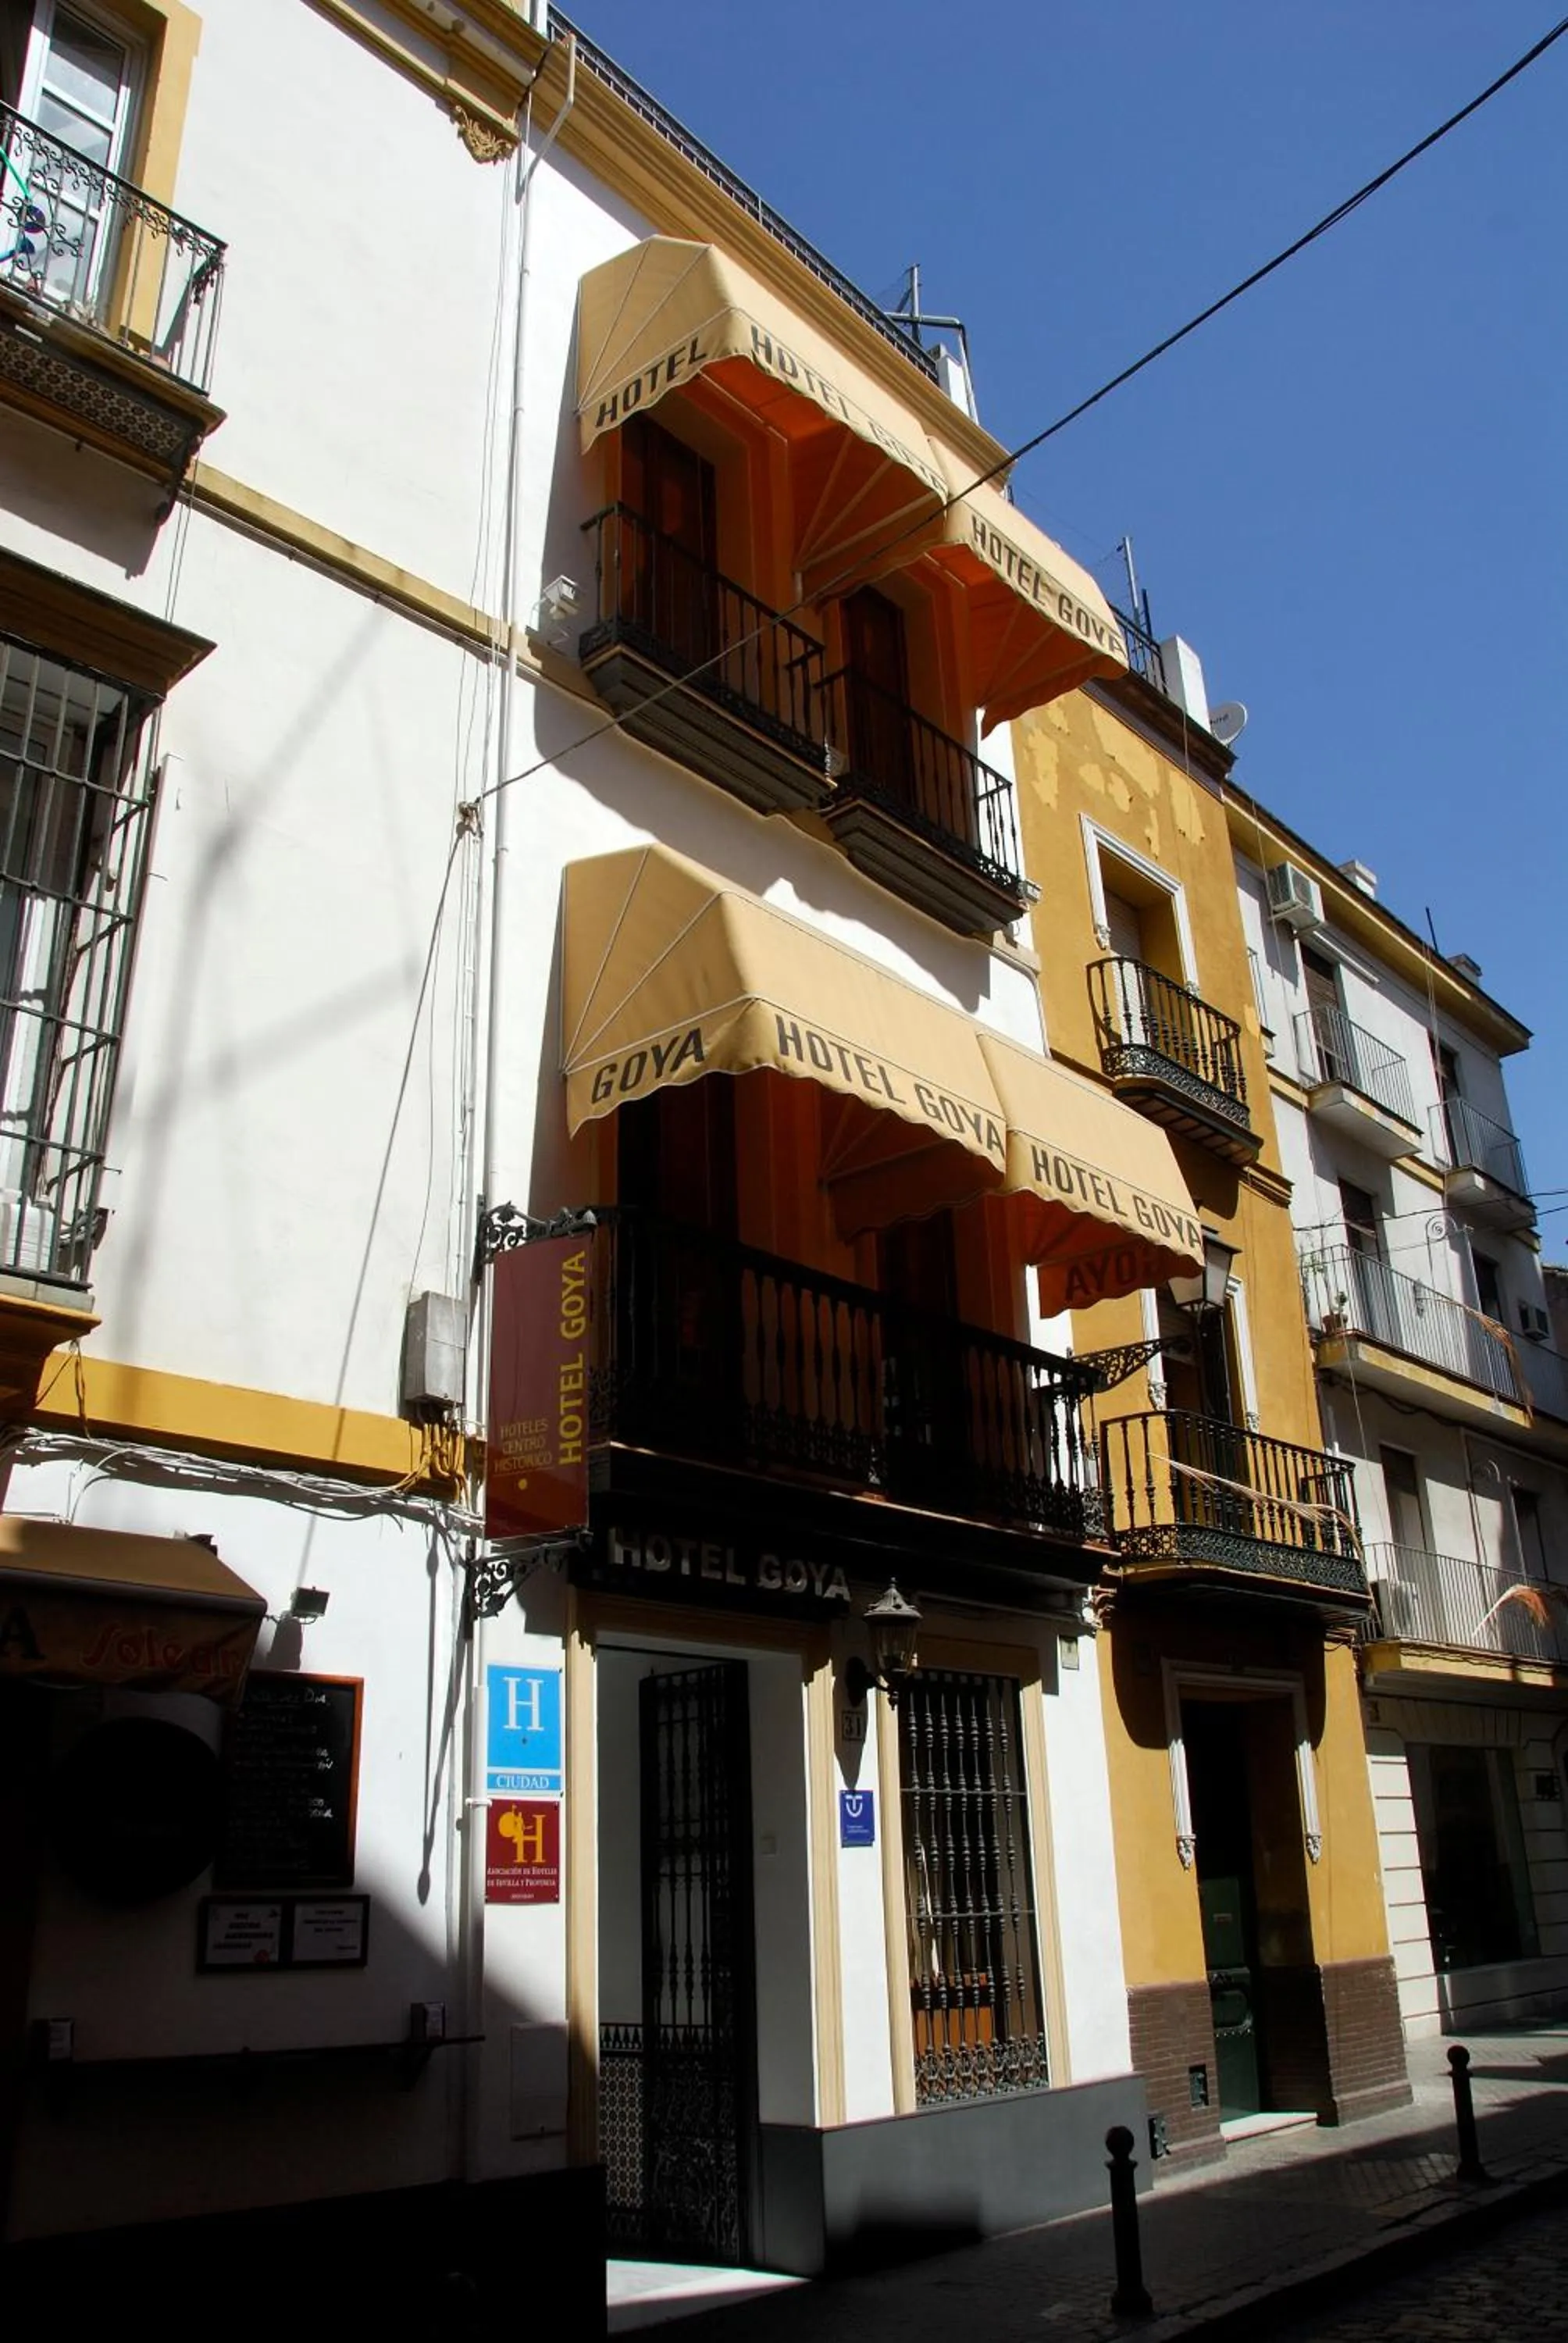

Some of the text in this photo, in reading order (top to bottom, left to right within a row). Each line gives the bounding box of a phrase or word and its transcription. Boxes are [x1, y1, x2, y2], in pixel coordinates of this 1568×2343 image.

[596, 337, 707, 428] HOTEL
[971, 514, 1128, 658] HOTEL GOYA
[591, 1027, 705, 1105] GOYA
[775, 1013, 1006, 1157] HOTEL GOYA
[1031, 1144, 1203, 1249] HOTEL GOYA
[558, 1250, 586, 1465] HOTEL GOYA
[500, 1418, 548, 1439] HOTELES
[607, 1525, 852, 1603] HOTEL GOYA
[502, 1676, 544, 1731] H
[496, 1774, 550, 1789] CIUDAD
